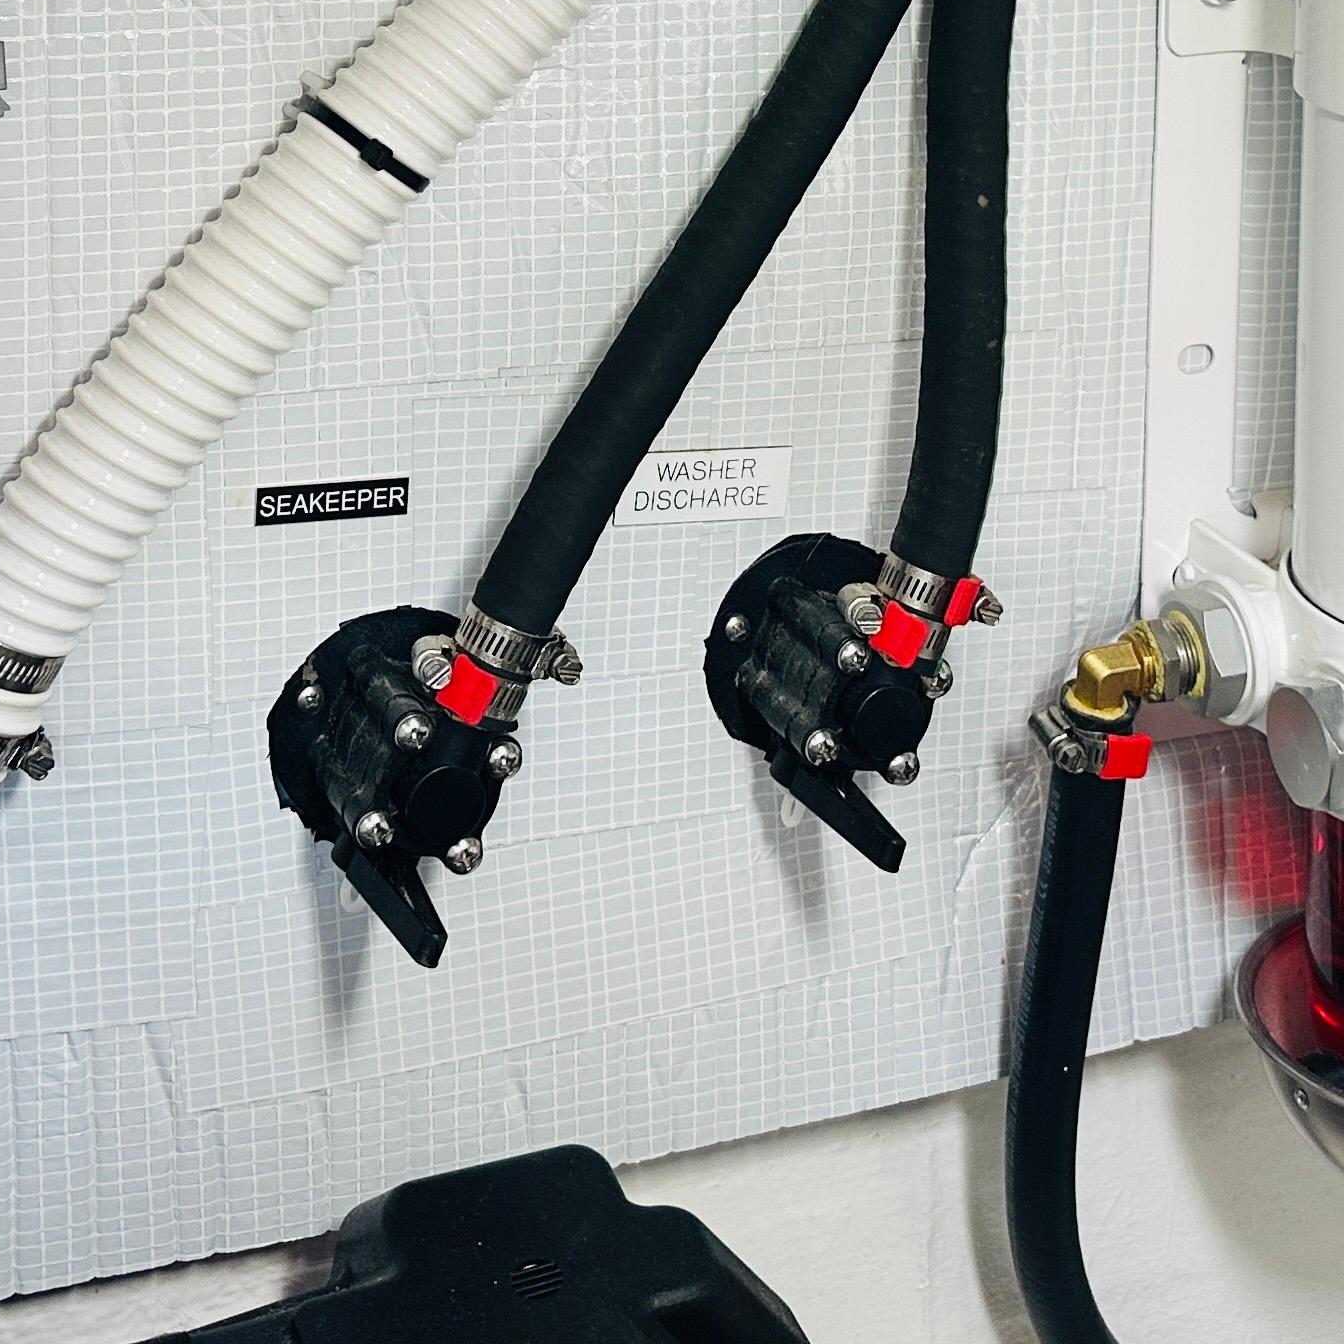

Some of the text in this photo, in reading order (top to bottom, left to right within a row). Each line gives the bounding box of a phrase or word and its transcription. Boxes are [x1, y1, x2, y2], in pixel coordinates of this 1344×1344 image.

[657, 457, 757, 482] WASHER
[258, 485, 406, 519] SEAKEEPER
[633, 484, 769, 513] DISCHARGE
